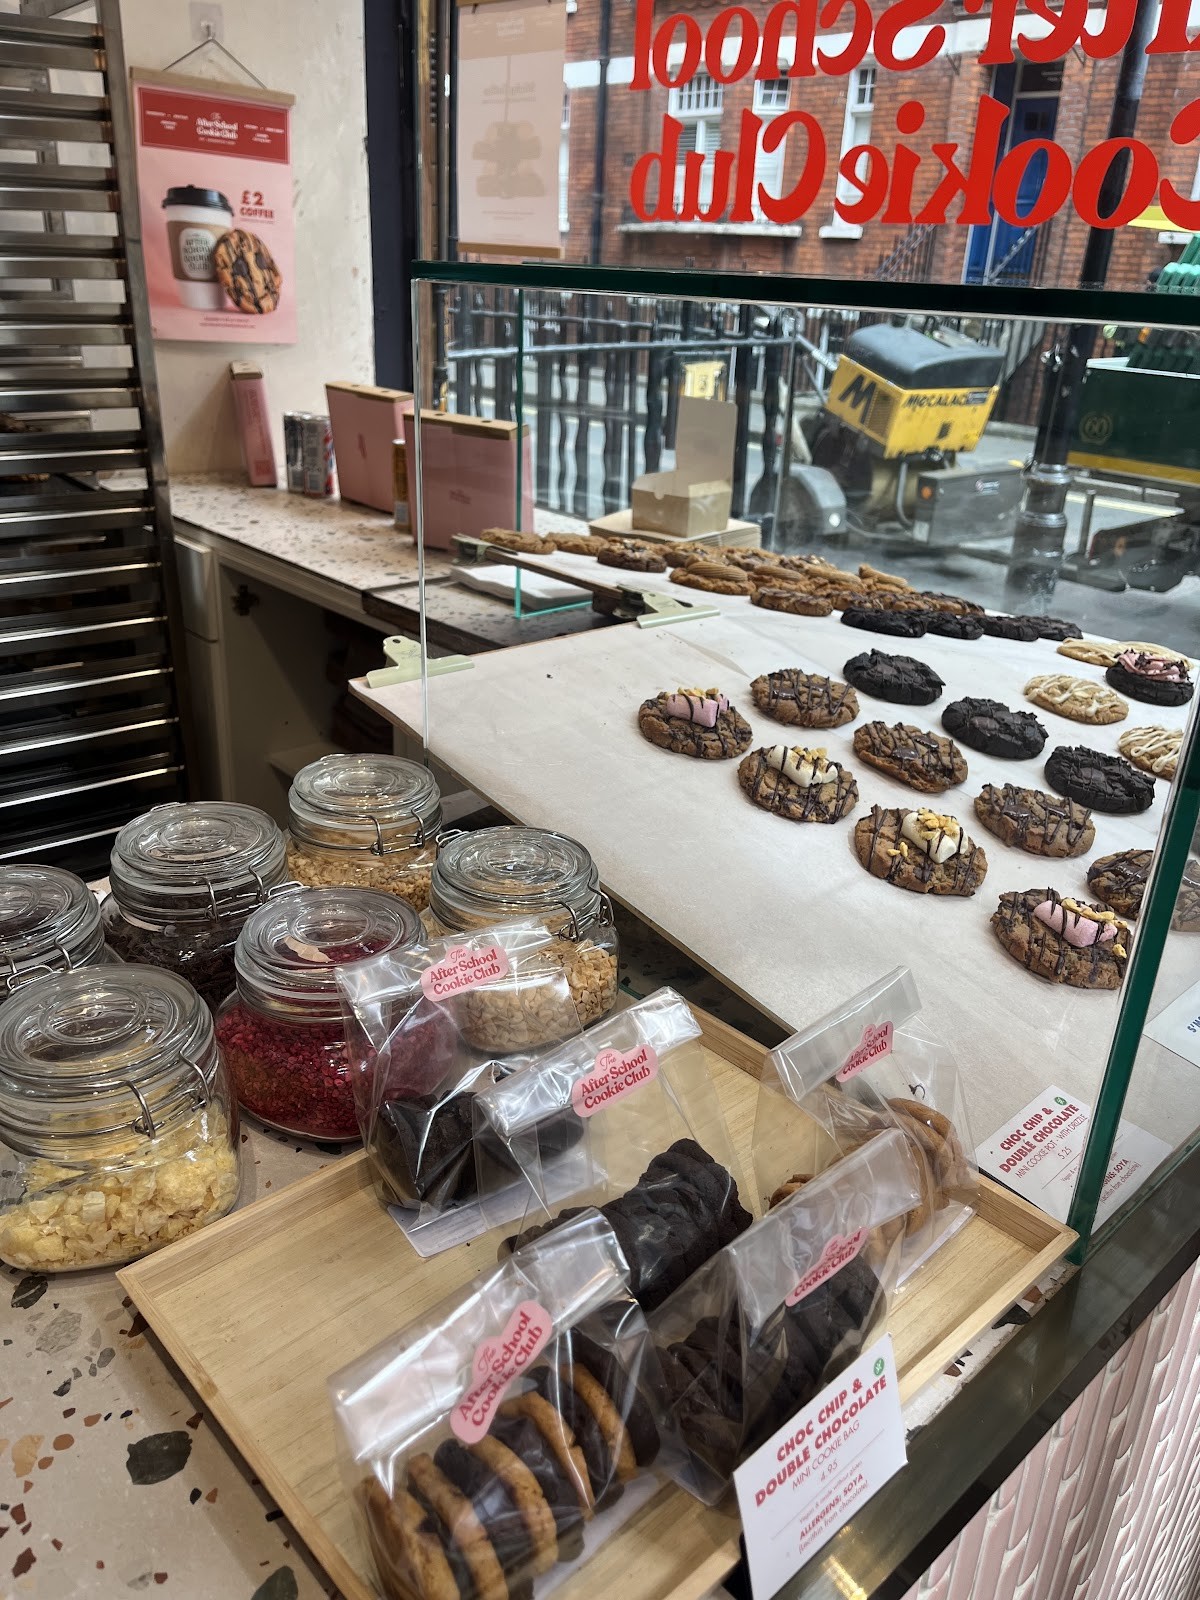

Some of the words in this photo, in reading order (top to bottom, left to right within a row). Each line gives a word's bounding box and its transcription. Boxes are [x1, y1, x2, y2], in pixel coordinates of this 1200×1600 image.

[240, 207, 274, 219] COFFEE
[241, 190, 264, 206] £2
[430, 964, 460, 984] After
[458, 948, 499, 972] School
[450, 948, 467, 964] The
[433, 973, 474, 996] Cookie
[473, 962, 501, 981] Club
[599, 1052, 617, 1072] The
[868, 1039, 887, 1057] Club
[581, 1073, 610, 1098] After
[609, 1048, 649, 1080] School
[584, 1081, 626, 1109] Cookie
[624, 1065, 651, 1087] Club
[998, 1140, 1037, 1174] DOUBLE
[1032, 1104, 1080, 1143] CHOCOLATE
[1000, 1129, 1027, 1151] CHOC
[1022, 1113, 1044, 1131] CHIP
[1041, 1107, 1055, 1116] &
[1015, 1164, 1030, 1179] MINI
[1026, 1148, 1049, 1168] COOKIE
[1044, 1139, 1058, 1152] POT
[1057, 1126, 1073, 1141] WITH
[1113, 1158, 1130, 1174] SOYA
[458, 1373, 494, 1422] After
[491, 1310, 532, 1375] School
[471, 1366, 518, 1427] Cookie
[514, 1325, 544, 1367] Club
[477, 1345, 497, 1375] The
[776, 1419, 815, 1462] CHOC
[817, 1389, 848, 1425] CHIP
[852, 1377, 863, 1394] &
[754, 1445, 811, 1508] DOUBLE
[813, 1374, 887, 1450] CHOCOLATE
[791, 1465, 811, 1492] MINI
[811, 1437, 843, 1471] COOKIE
[843, 1419, 860, 1442] BAG
[842, 1472, 864, 1497] SOYA
